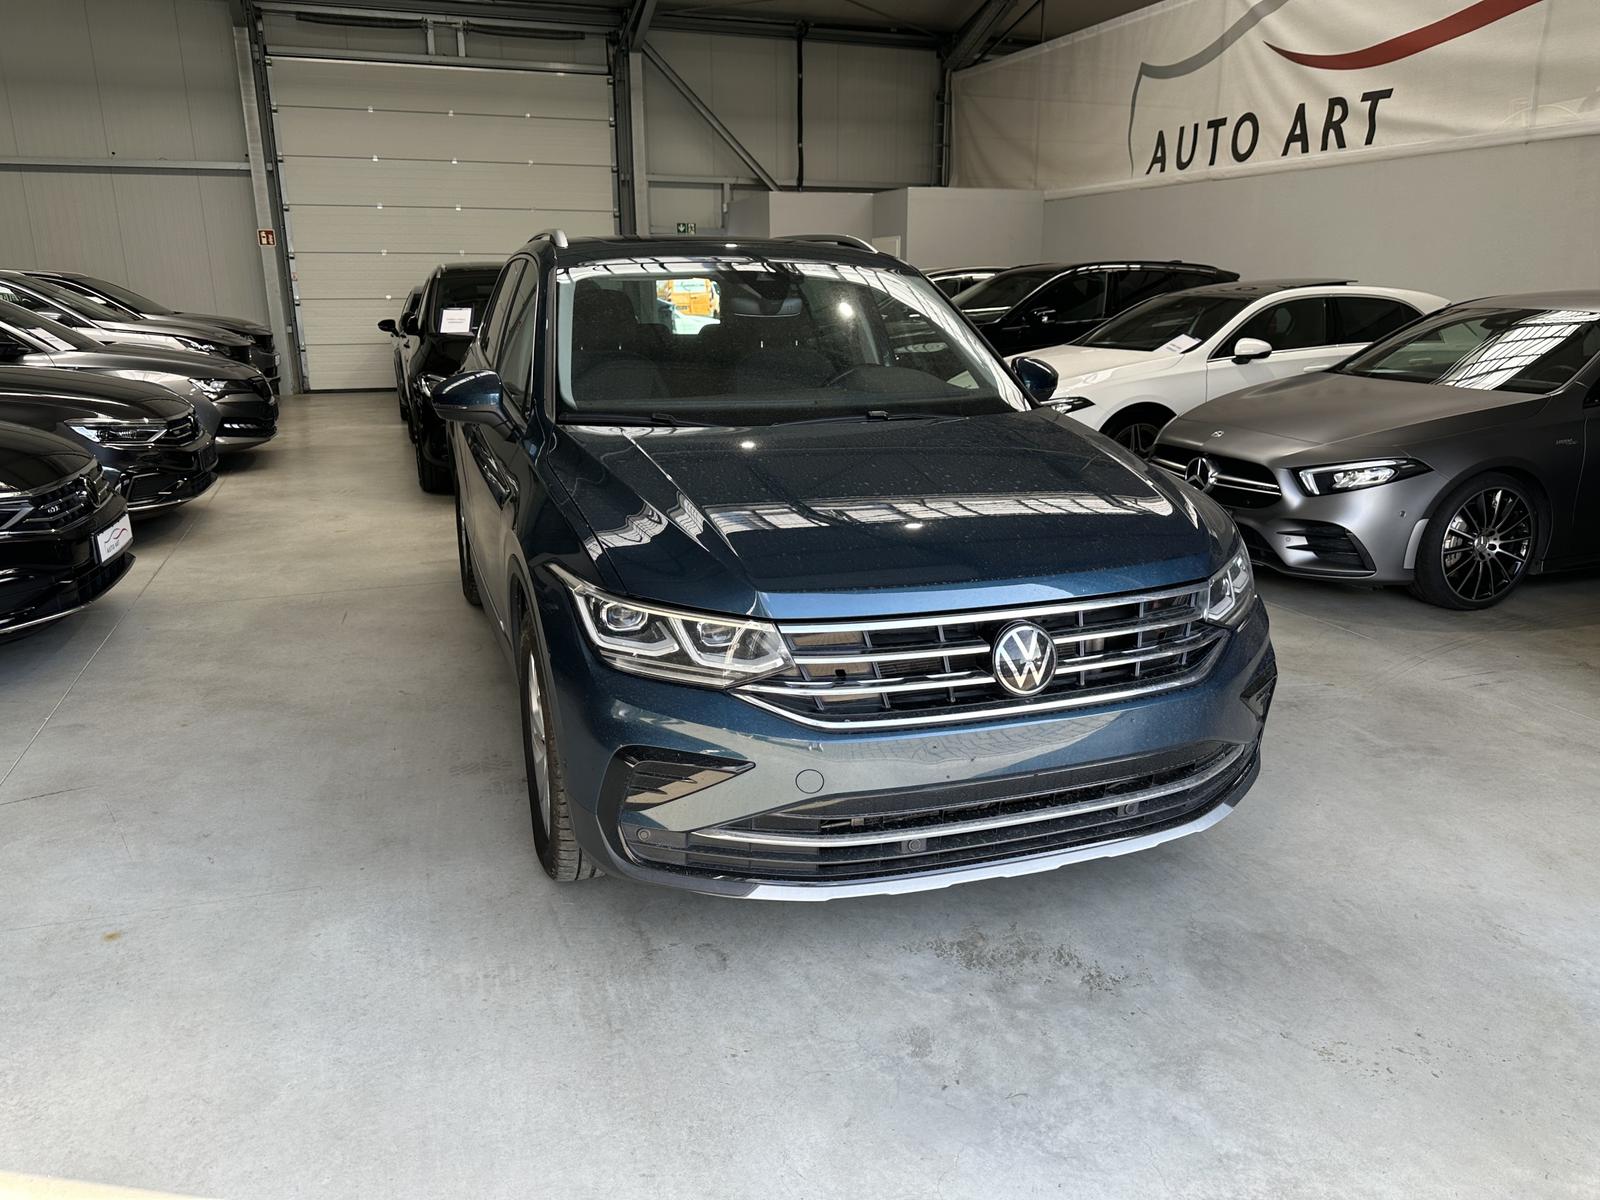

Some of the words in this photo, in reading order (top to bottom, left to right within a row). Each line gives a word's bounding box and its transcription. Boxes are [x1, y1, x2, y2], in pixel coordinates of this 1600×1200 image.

[1145, 112, 1260, 175] AUTO
[1281, 88, 1394, 157] ART
[997, 625, 1054, 692] VW
